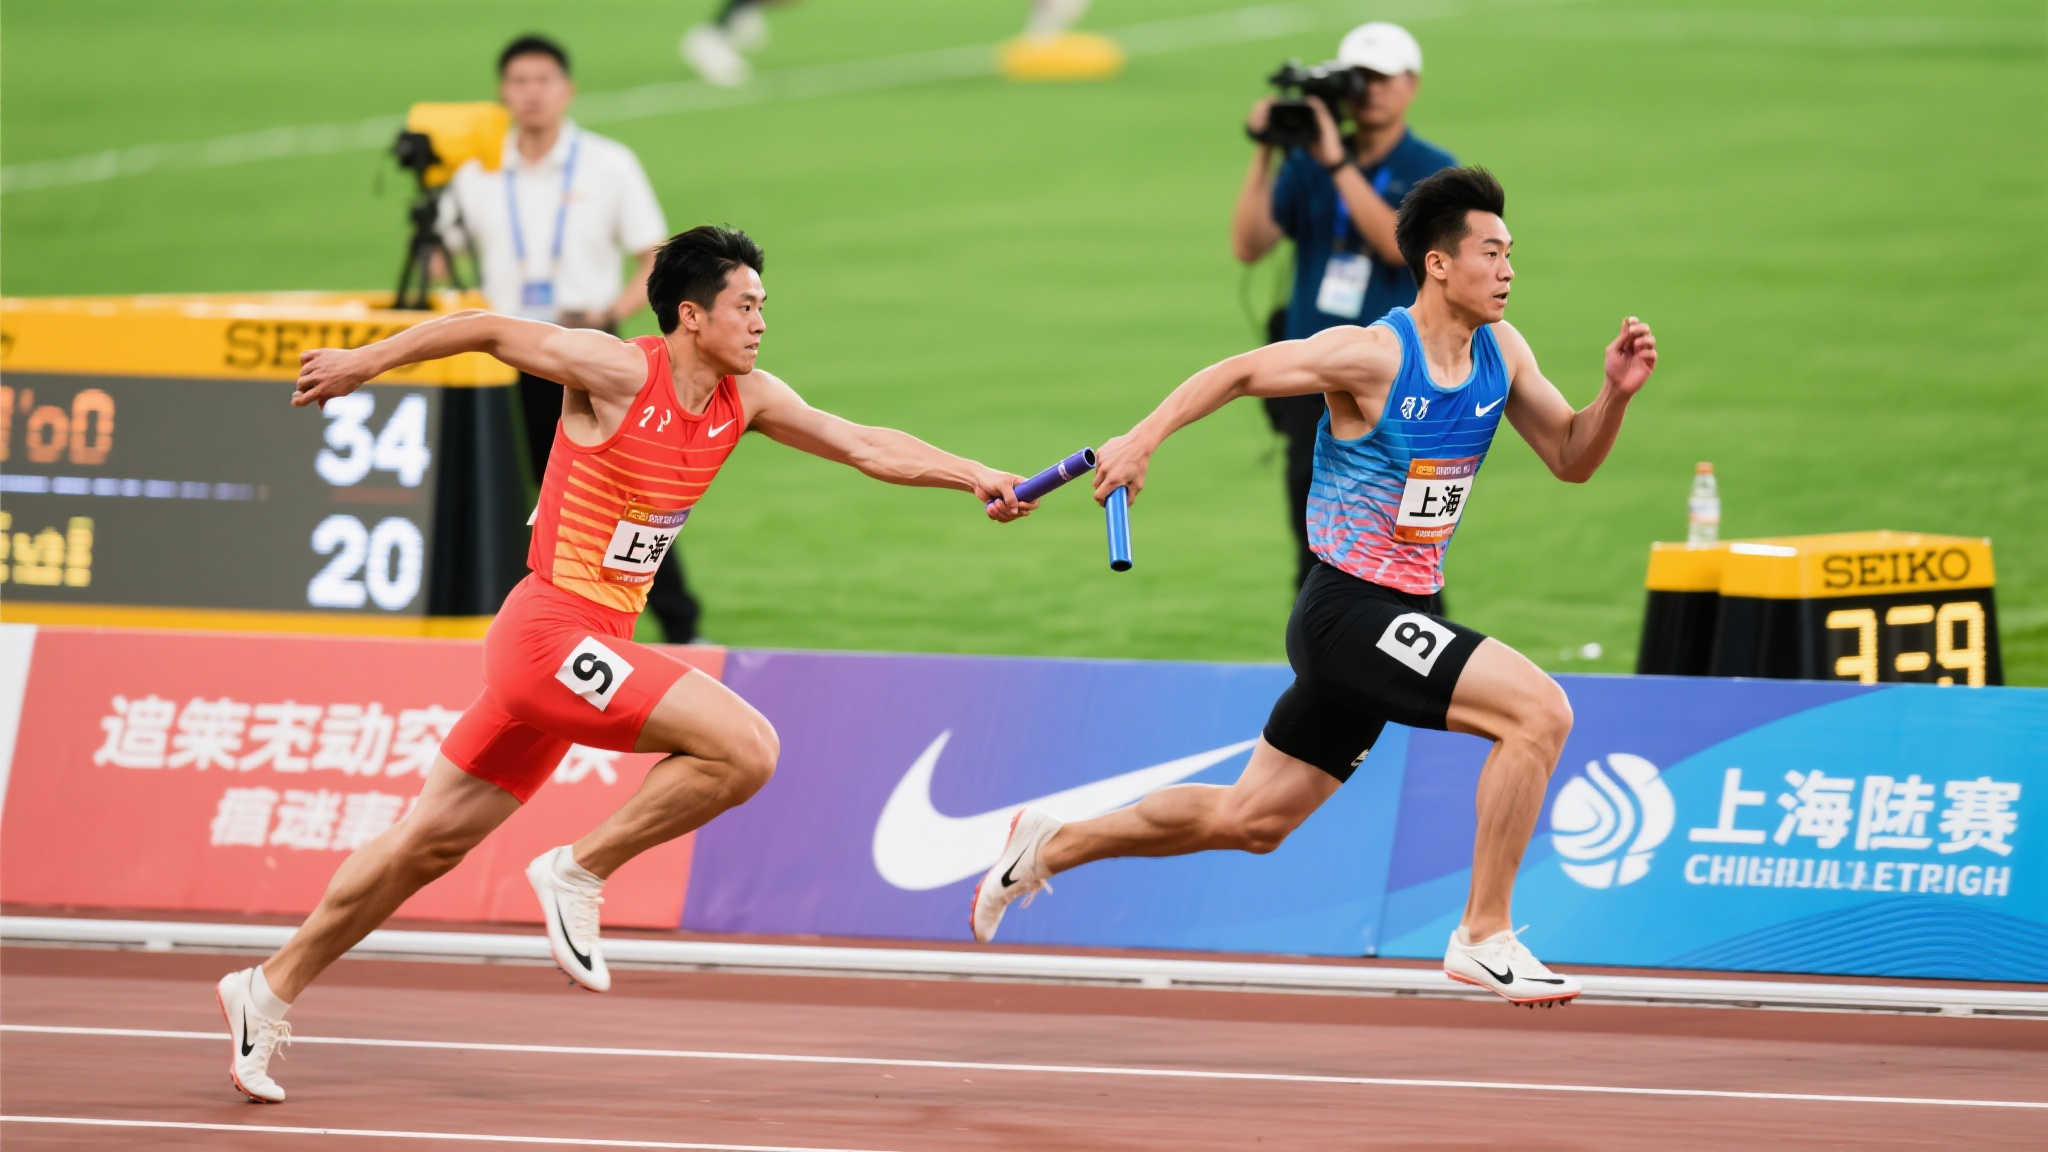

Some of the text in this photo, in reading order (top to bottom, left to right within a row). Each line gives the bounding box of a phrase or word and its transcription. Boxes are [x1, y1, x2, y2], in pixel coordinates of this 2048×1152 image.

[314, 392, 431, 487] 34
[1409, 485, 1463, 517] 上海
[307, 513, 424, 611] 20
[1823, 548, 1971, 588] SEIKO
